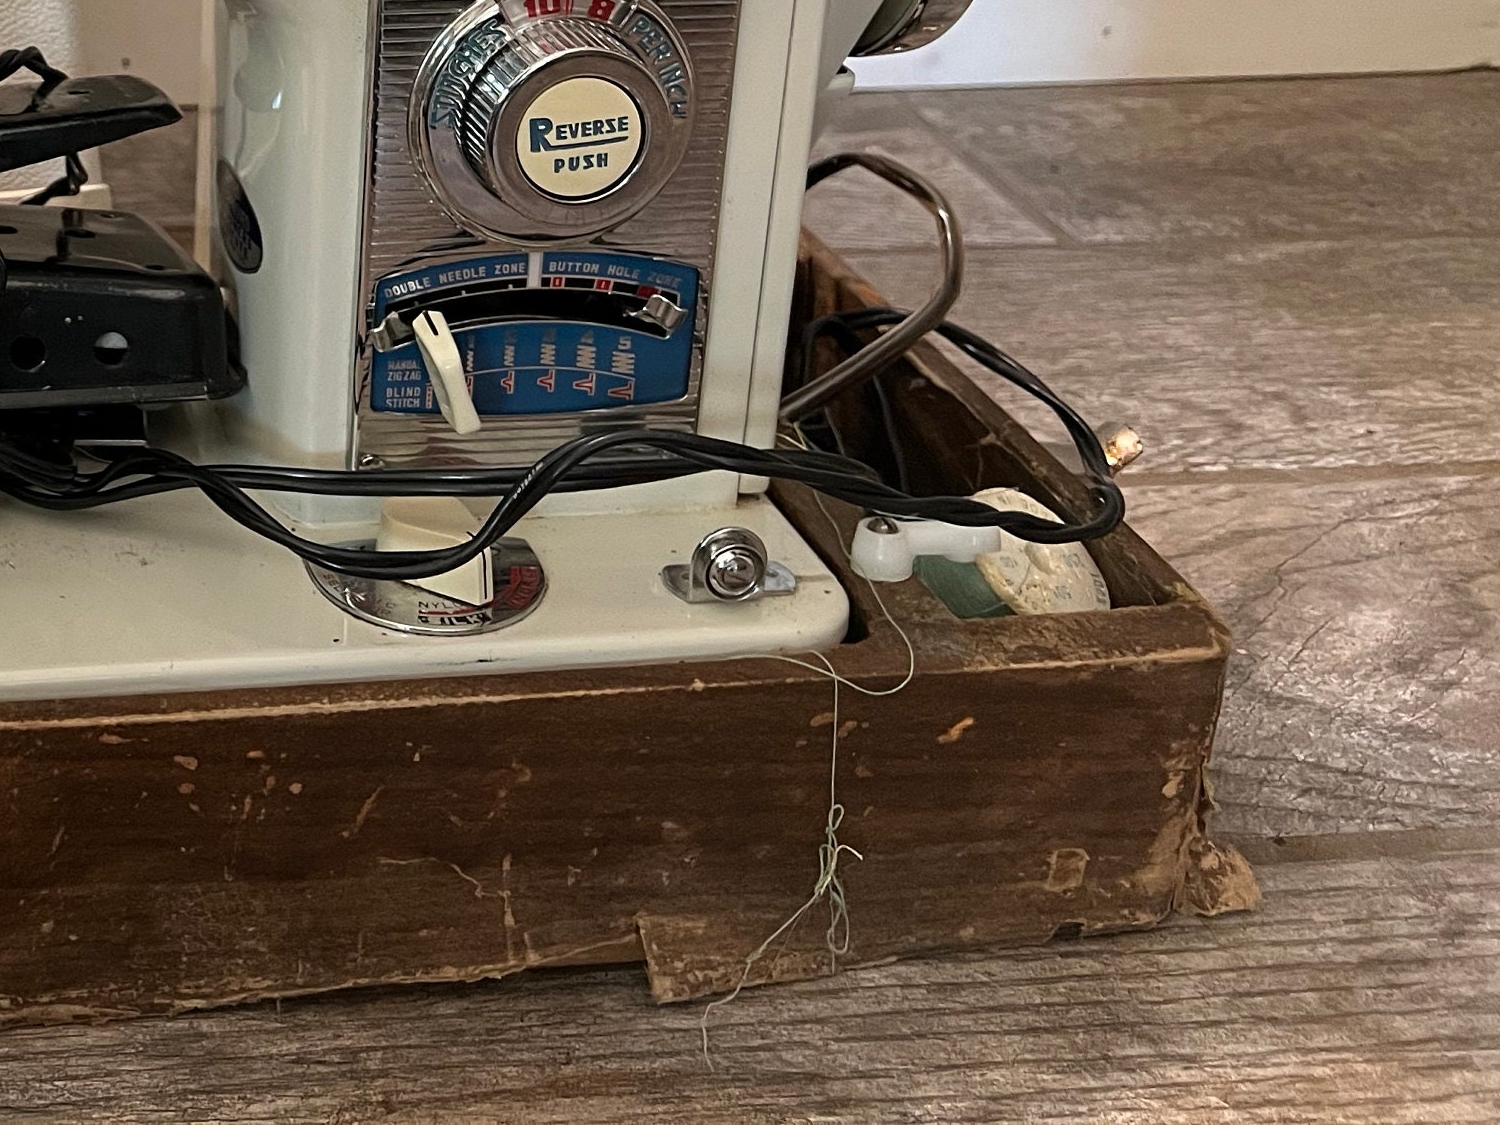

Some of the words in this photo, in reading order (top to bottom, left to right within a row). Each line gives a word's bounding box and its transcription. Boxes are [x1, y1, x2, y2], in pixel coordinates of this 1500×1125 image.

[627, 15, 672, 65] PER
[659, 61, 688, 119] INCH
[529, 116, 629, 153] REVERSE
[554, 152, 608, 173] PUSH
[384, 277, 431, 298] DOUBLE
[439, 266, 486, 284] NEEDLE
[494, 262, 526, 275] ZONE
[549, 261, 599, 274] BUTTON
[607, 264, 641, 279] HOLE
[647, 271, 682, 287] ZONE
[618, 335, 632, 350] 5
[387, 371, 402, 381] ZIG
[403, 370, 422, 381] ZAG
[386, 386, 421, 398] BLIND
[385, 398, 420, 408] STITCH
